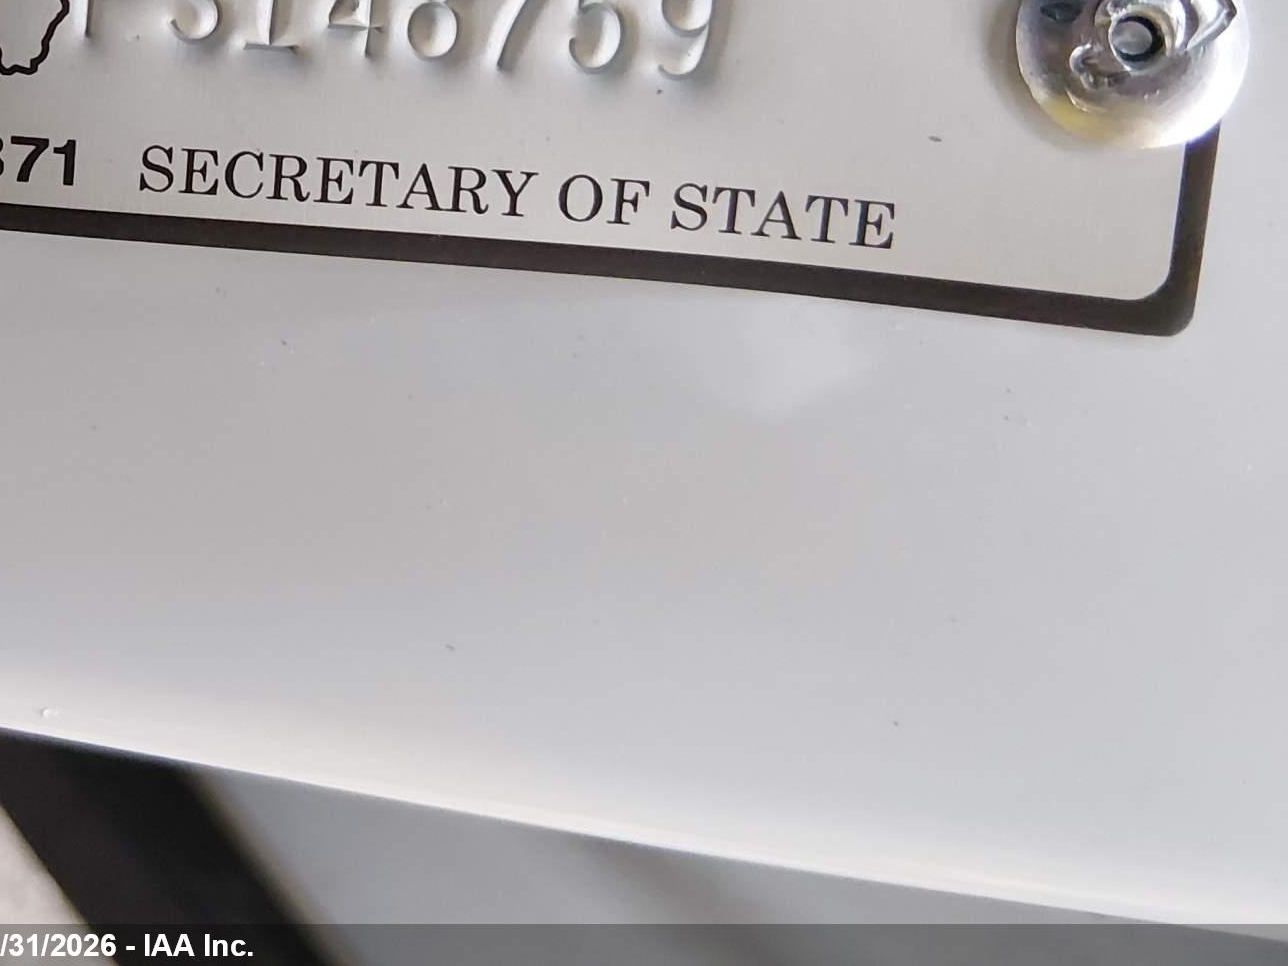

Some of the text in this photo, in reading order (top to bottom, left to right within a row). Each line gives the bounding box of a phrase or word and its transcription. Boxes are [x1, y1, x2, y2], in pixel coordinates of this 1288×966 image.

[139, 144, 895, 250] SECRETARY OF STATE
